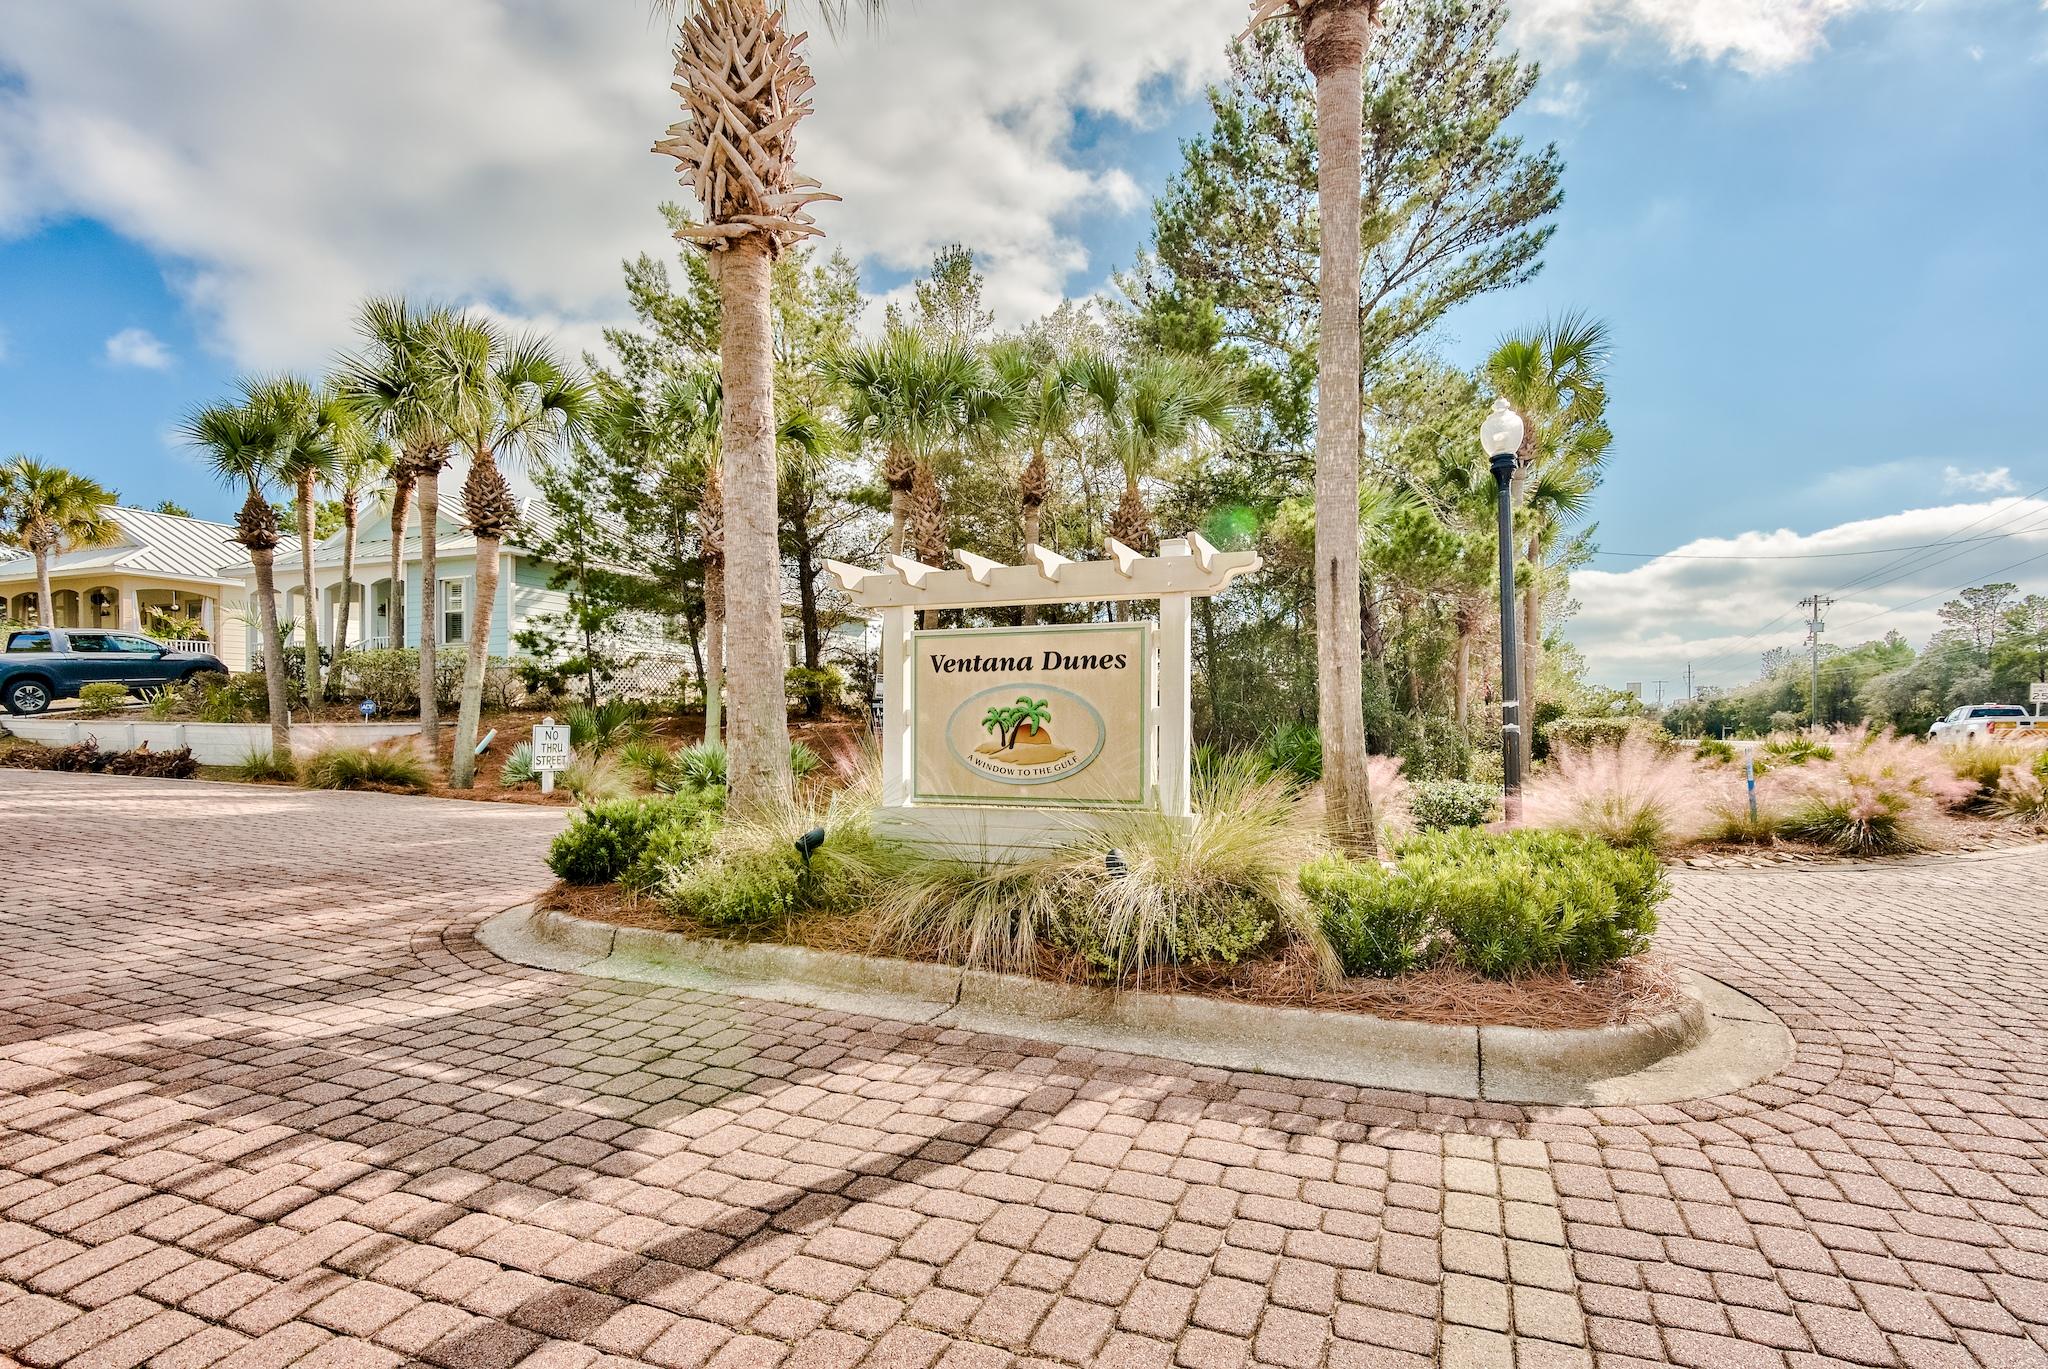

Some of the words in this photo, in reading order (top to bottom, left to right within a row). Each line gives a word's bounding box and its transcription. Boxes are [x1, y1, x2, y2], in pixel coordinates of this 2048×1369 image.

[930, 654, 1034, 673] Ventana
[1041, 651, 1127, 671] Dunes
[545, 730, 559, 740] NO
[541, 743, 563, 753] THRU
[535, 755, 567, 765] STREET
[975, 758, 1015, 776] WINDOW
[1033, 765, 1053, 776] THE
[1054, 755, 1078, 771] GULF
